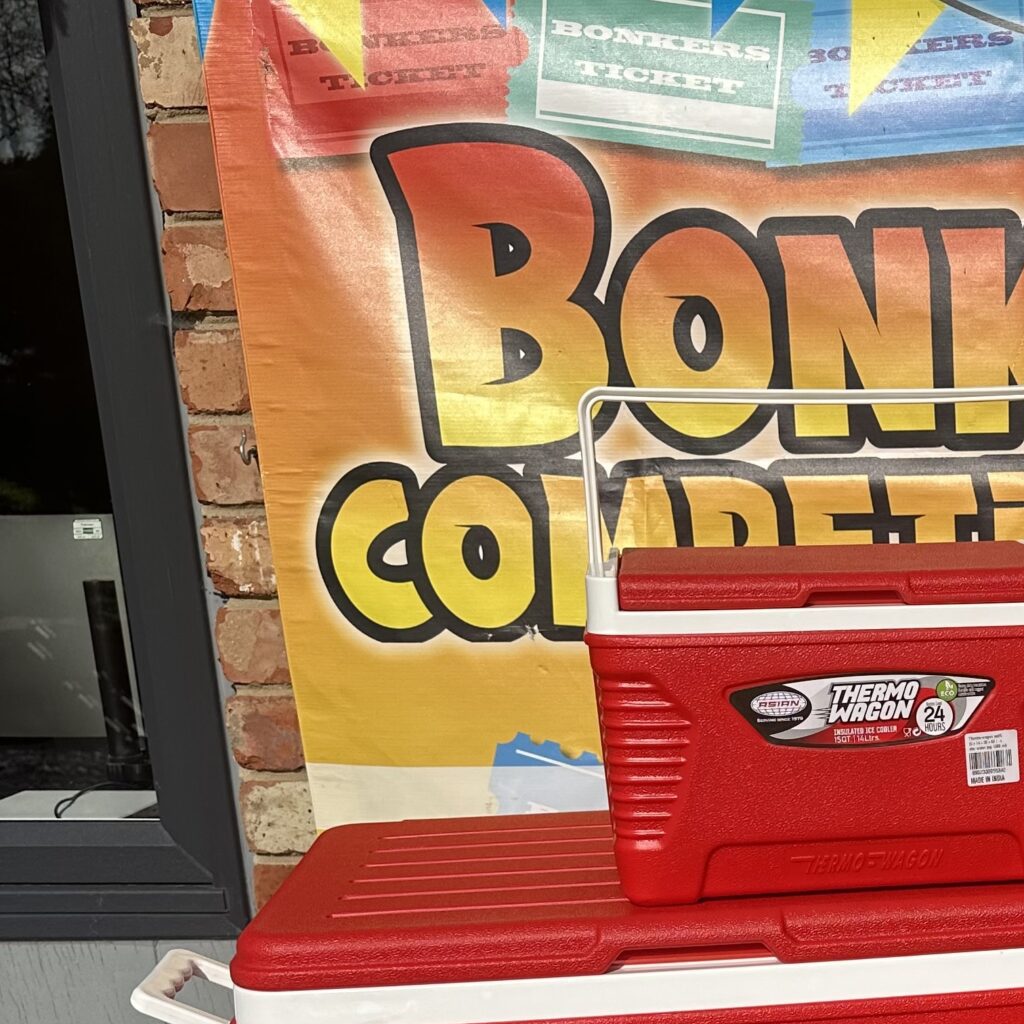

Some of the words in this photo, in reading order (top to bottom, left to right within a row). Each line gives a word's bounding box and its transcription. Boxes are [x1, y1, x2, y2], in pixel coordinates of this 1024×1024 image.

[288, 24, 508, 56] BNKERS
[551, 19, 771, 62] BONKERS
[808, 30, 1014, 64] BOERS
[575, 59, 745, 95] TICKET
[824, 70, 992, 99] TCKET
[758, 700, 800, 708] ASIAN
[832, 681, 919, 704] THERMO
[828, 699, 914, 723] WAGON
[924, 706, 945, 722] 24
[833, 727, 864, 735] INSULATED
[876, 725, 897, 733] COOLER
[924, 722, 946, 731] HOURS
